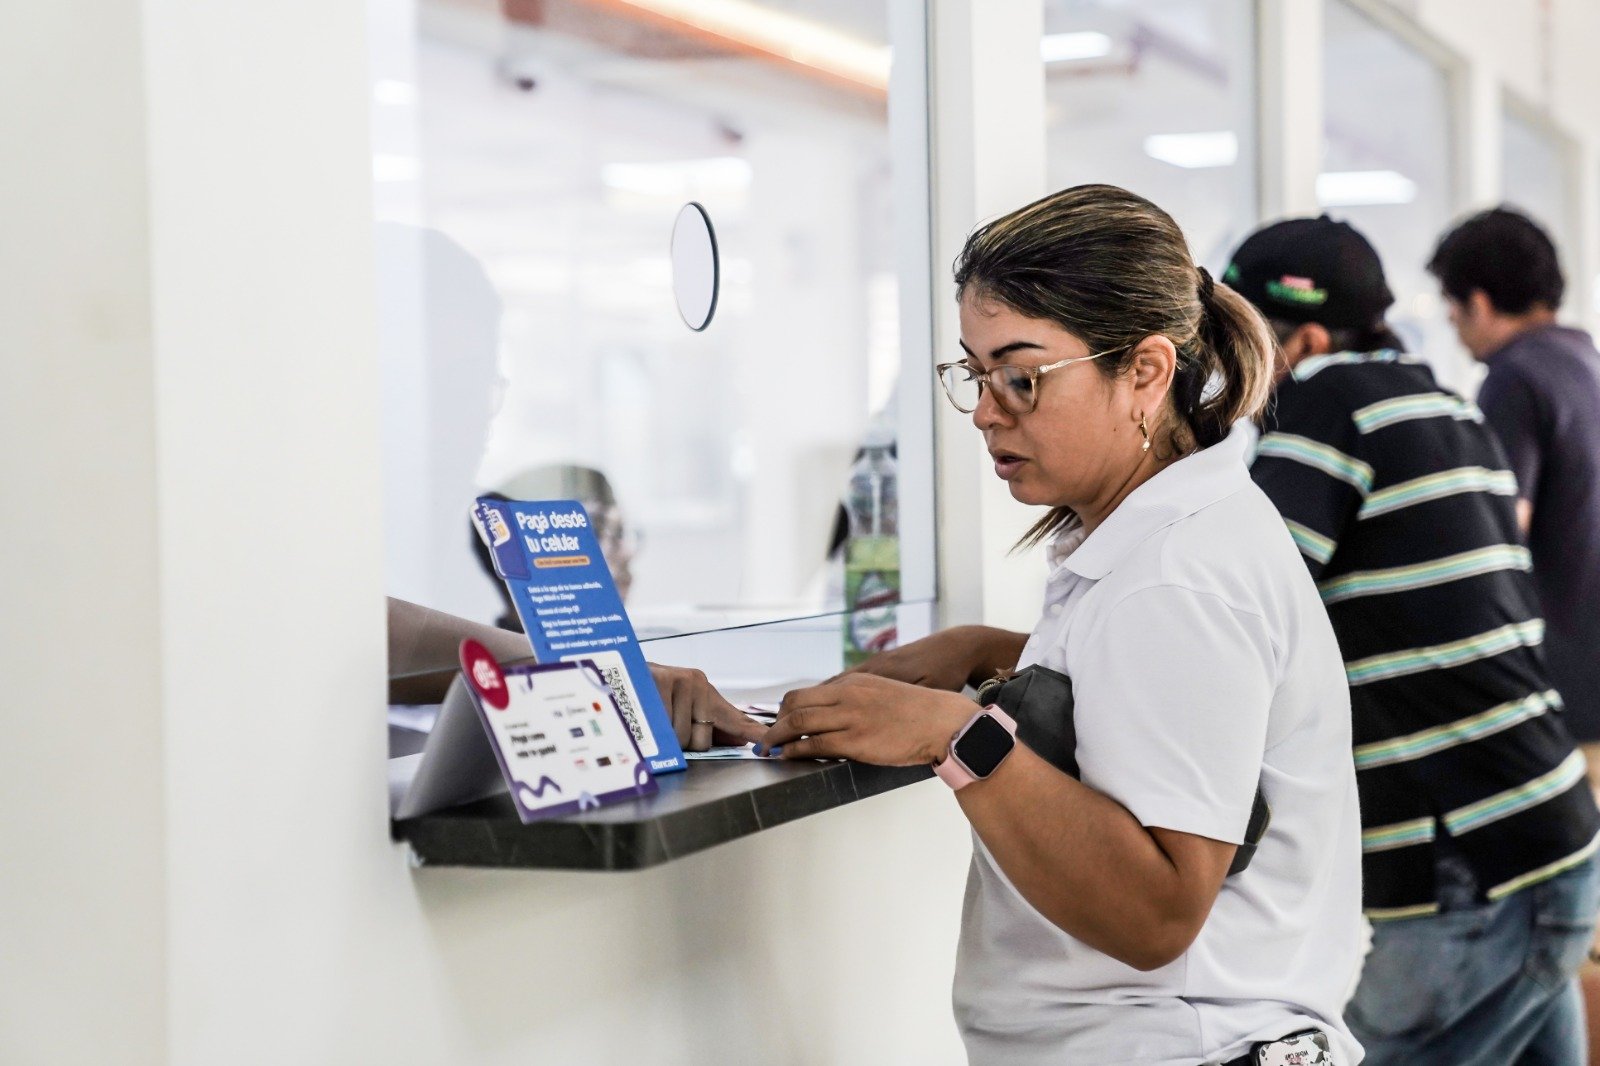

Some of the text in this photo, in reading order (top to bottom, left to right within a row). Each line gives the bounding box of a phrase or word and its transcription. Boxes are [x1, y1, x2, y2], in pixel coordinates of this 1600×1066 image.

[516, 510, 587, 534] Pagá desde
[524, 533, 580, 552] tu celular
[651, 757, 679, 770] Bancard
